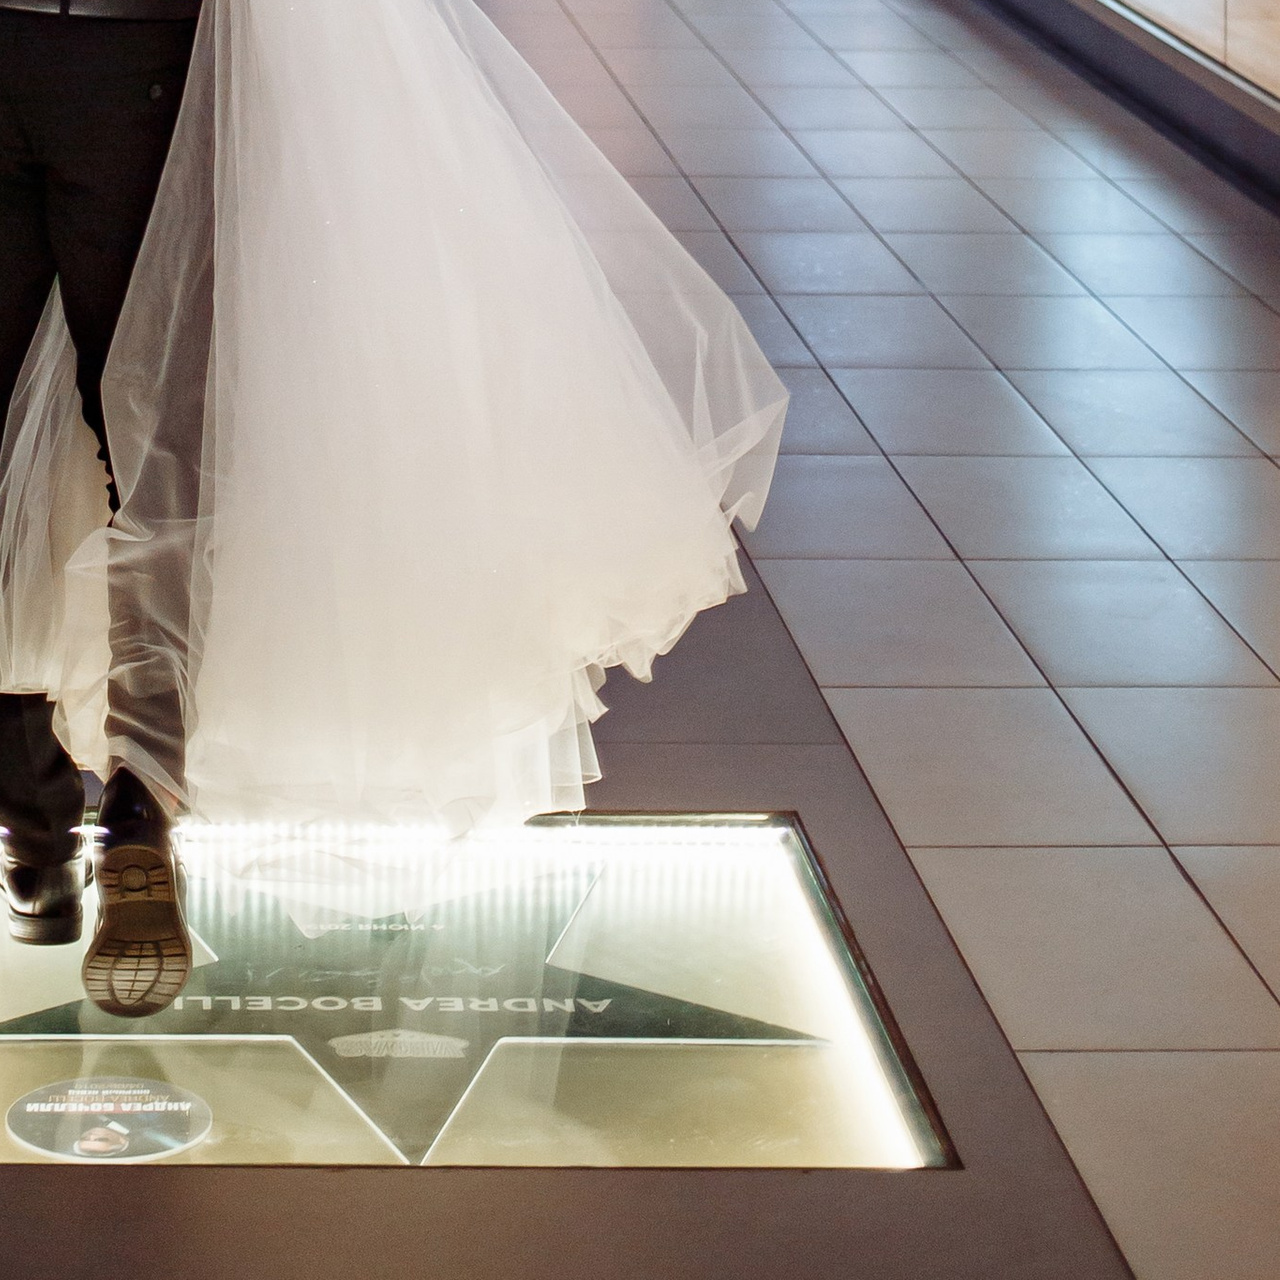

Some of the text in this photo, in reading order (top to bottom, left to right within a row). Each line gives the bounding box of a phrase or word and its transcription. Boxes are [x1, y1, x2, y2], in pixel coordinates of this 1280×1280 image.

[357, 923, 426, 932] ИЮНЯ
[173, 995, 613, 1014] ANDREA BOCELLI
[25, 1100, 192, 1113] АНДРЕА БОЧЕЛЛИ
